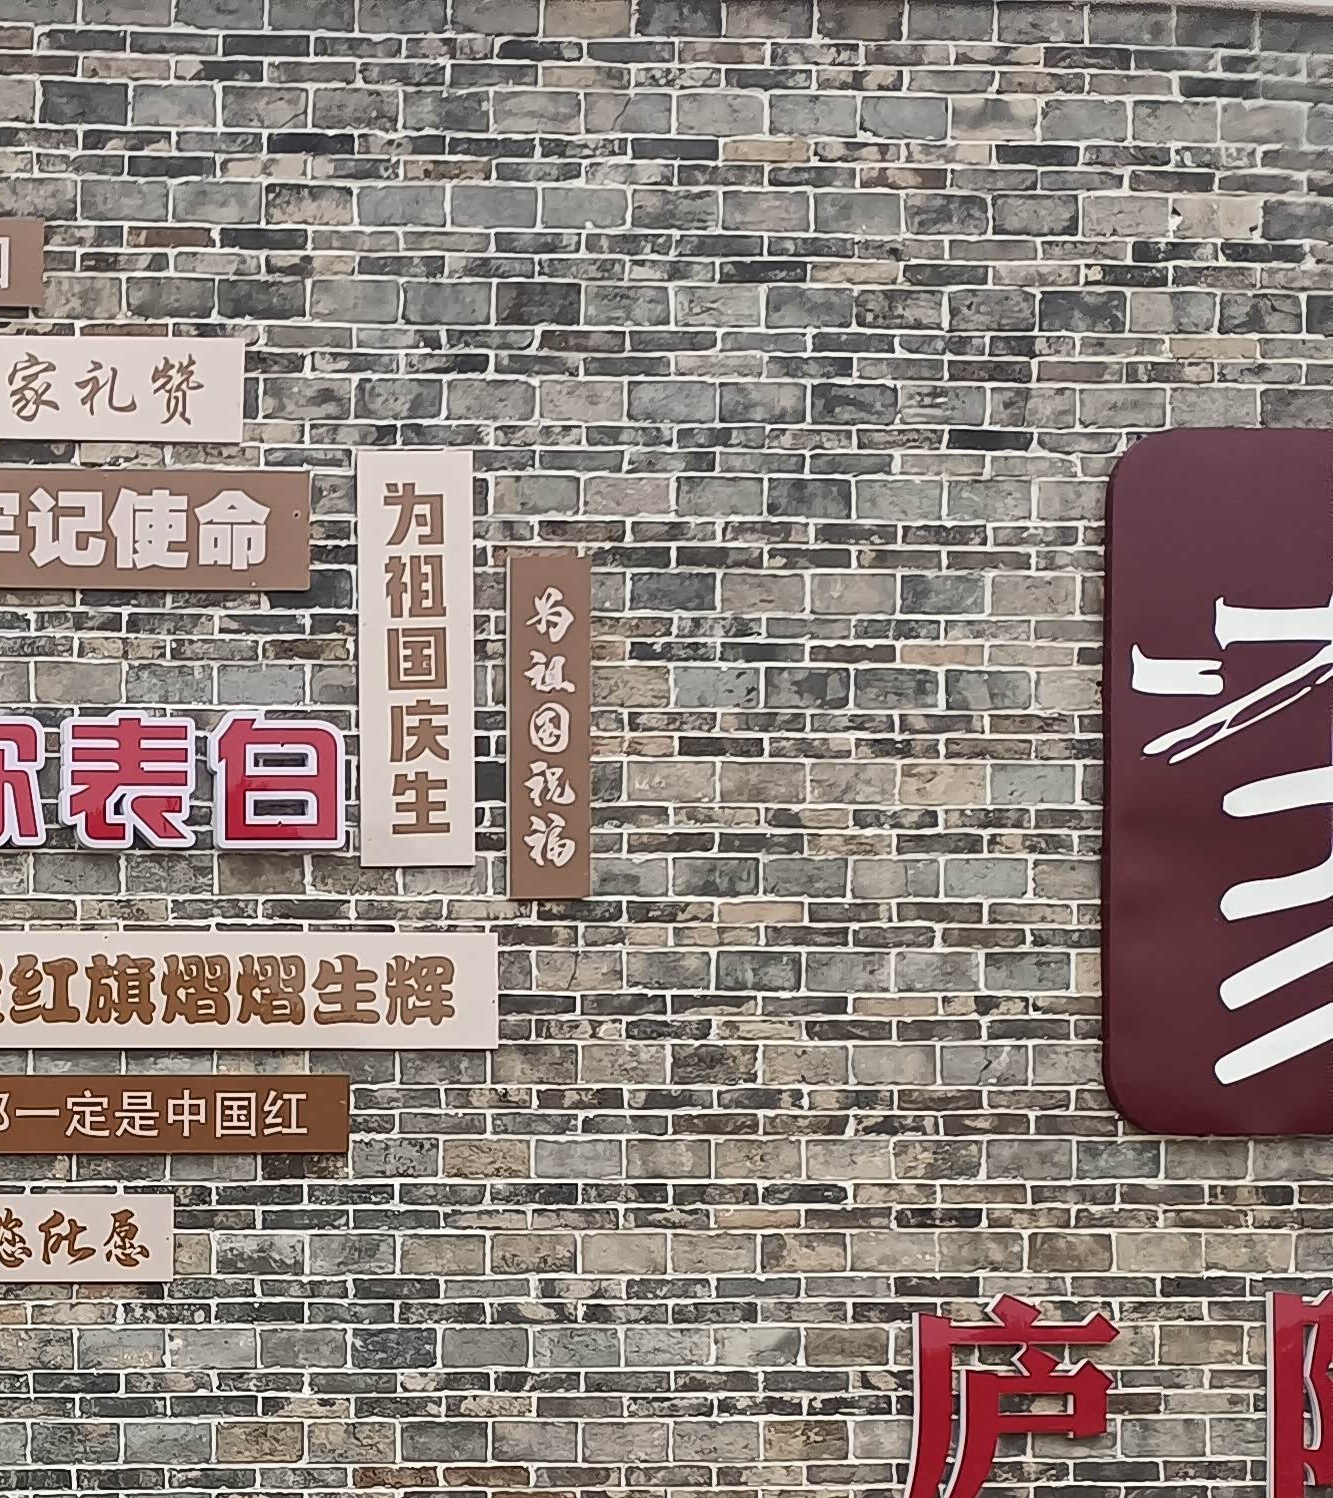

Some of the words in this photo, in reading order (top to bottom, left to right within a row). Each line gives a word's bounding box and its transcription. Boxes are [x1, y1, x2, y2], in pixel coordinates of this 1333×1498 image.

[383, 482, 451, 835] 为祖国庆生
[524, 587, 577, 867] 为祖国祝福
